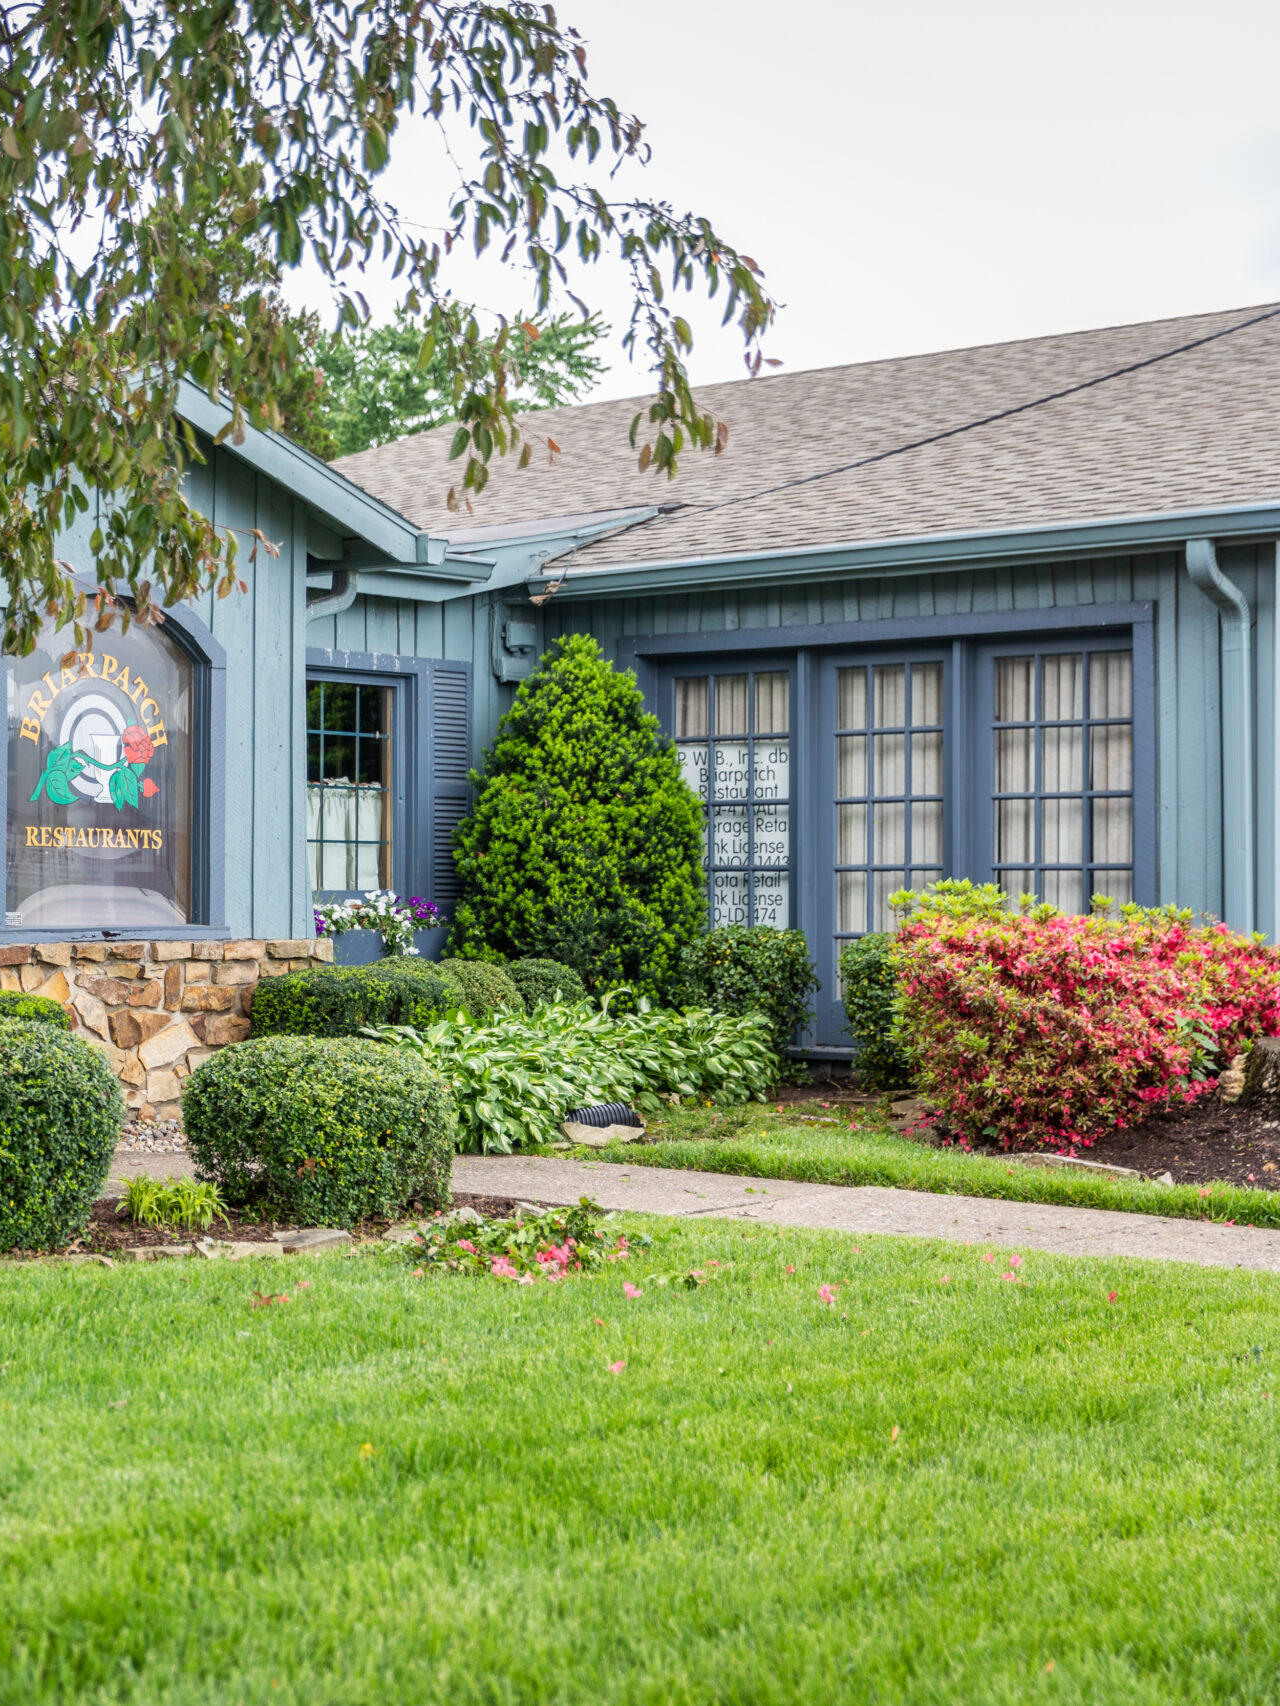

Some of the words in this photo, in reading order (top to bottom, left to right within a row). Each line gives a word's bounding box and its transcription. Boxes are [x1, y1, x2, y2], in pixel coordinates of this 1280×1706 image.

[19, 652, 169, 746] BRIARPATCH
[700, 766, 775, 785] Biarptch
[700, 784, 779, 799] Rstauant
[24, 826, 164, 850] RESTAURANTS
[732, 838, 785, 854] License
[732, 890, 783, 906] License
